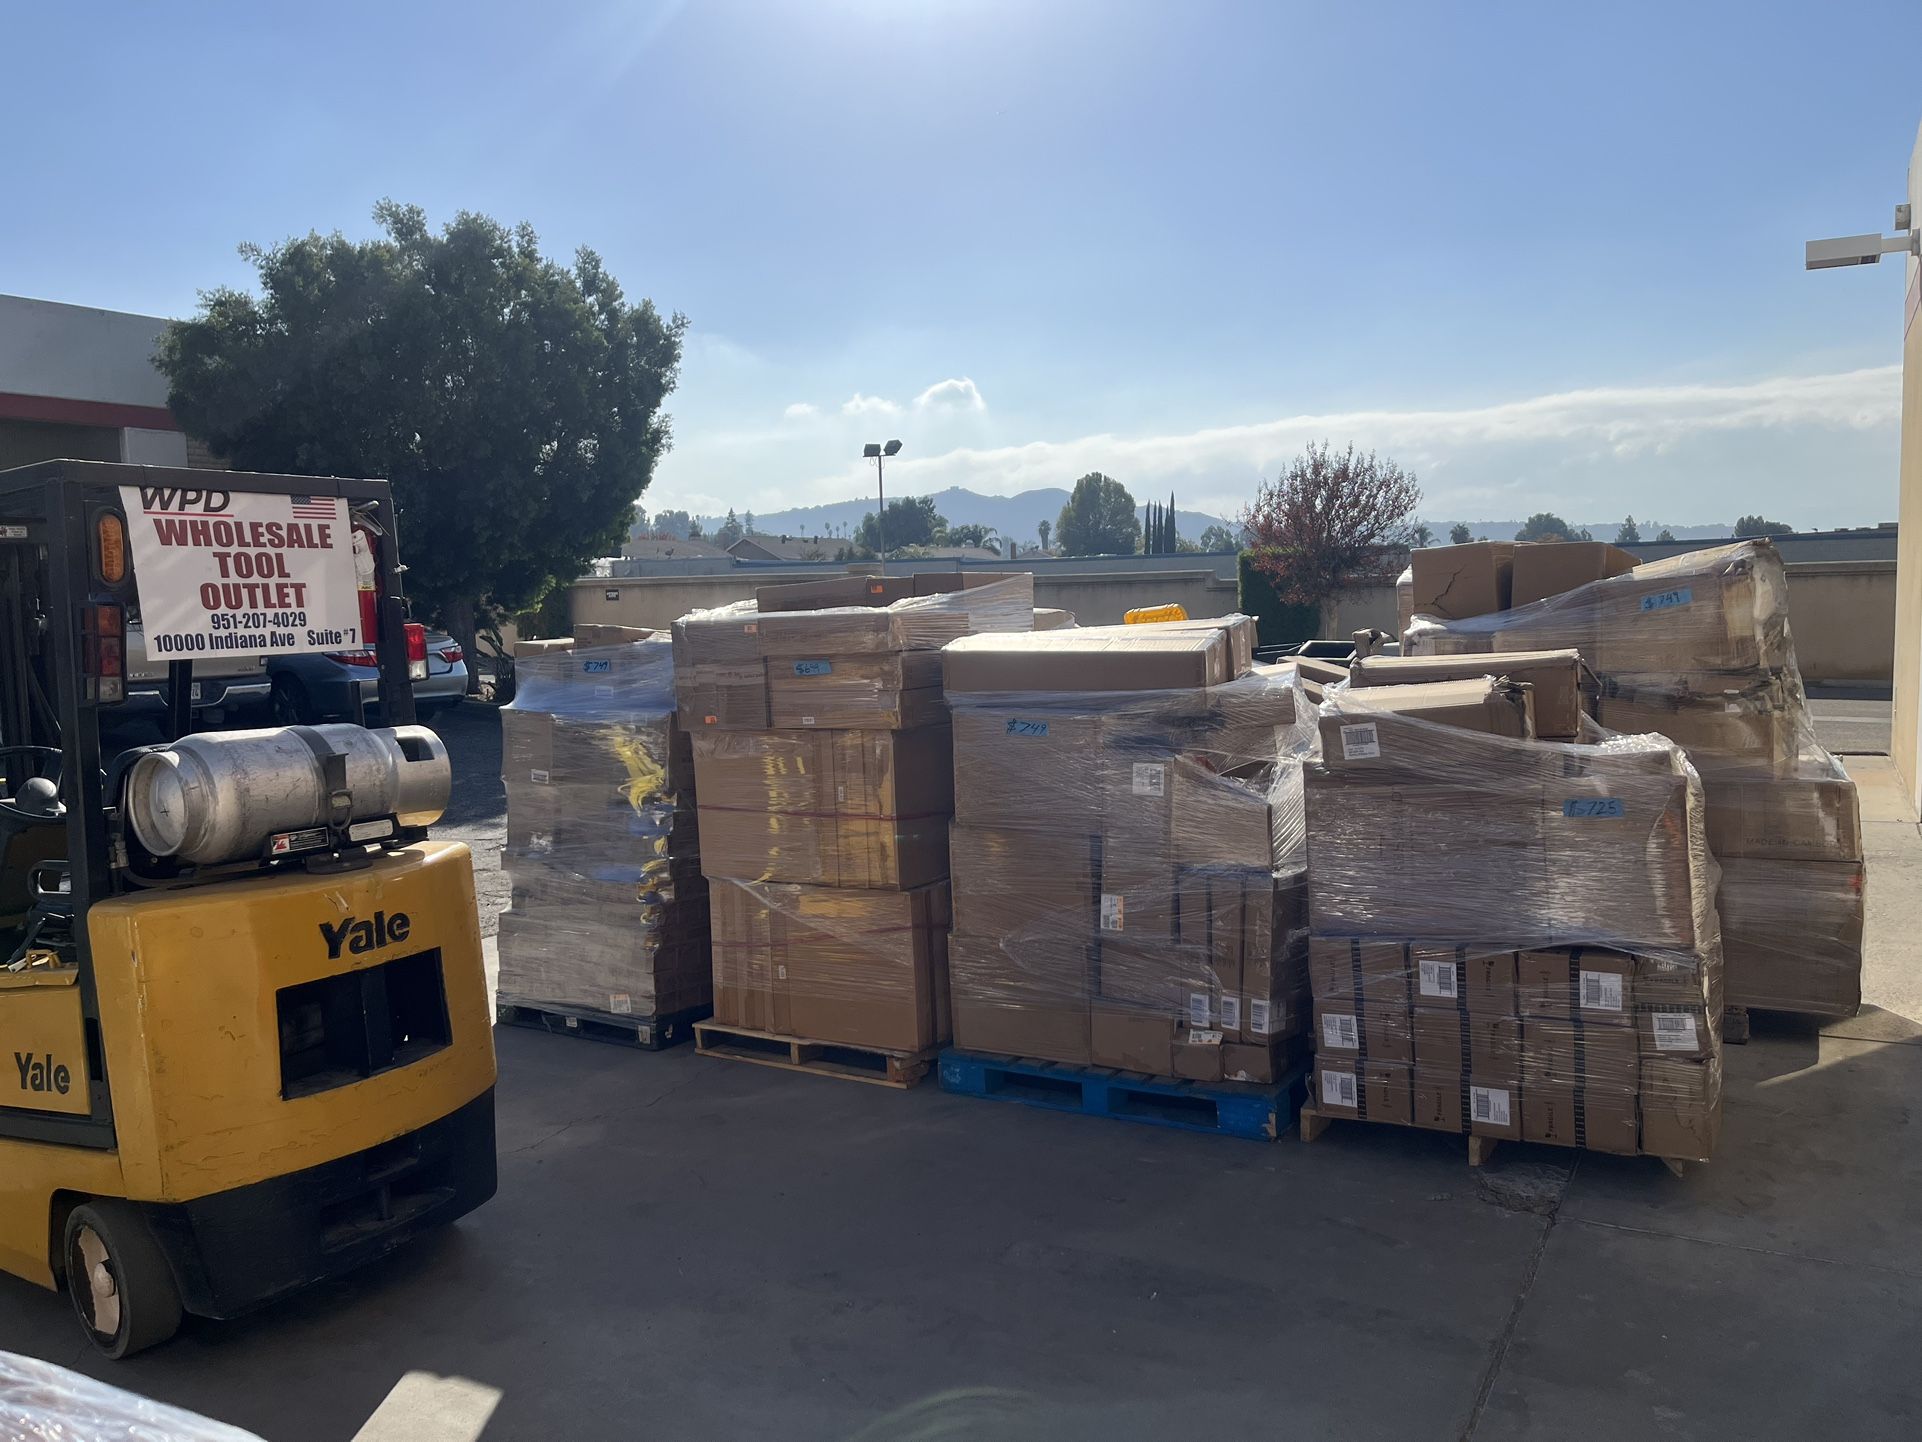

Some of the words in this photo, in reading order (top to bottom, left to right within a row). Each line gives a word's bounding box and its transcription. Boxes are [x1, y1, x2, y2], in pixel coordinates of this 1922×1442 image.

[139, 486, 230, 513] WPD
[153, 518, 333, 549] WHOLESALE
[213, 552, 291, 578] TOOL
[200, 582, 306, 610] OUTLET
[211, 611, 307, 630] 951-207-4029
[154, 633, 206, 652] 10000
[209, 632, 267, 650] Indiana
[270, 631, 295, 647] Ave
[307, 629, 342, 646] Suite
[318, 910, 411, 960] Yale
[14, 1052, 71, 1095] Yale
